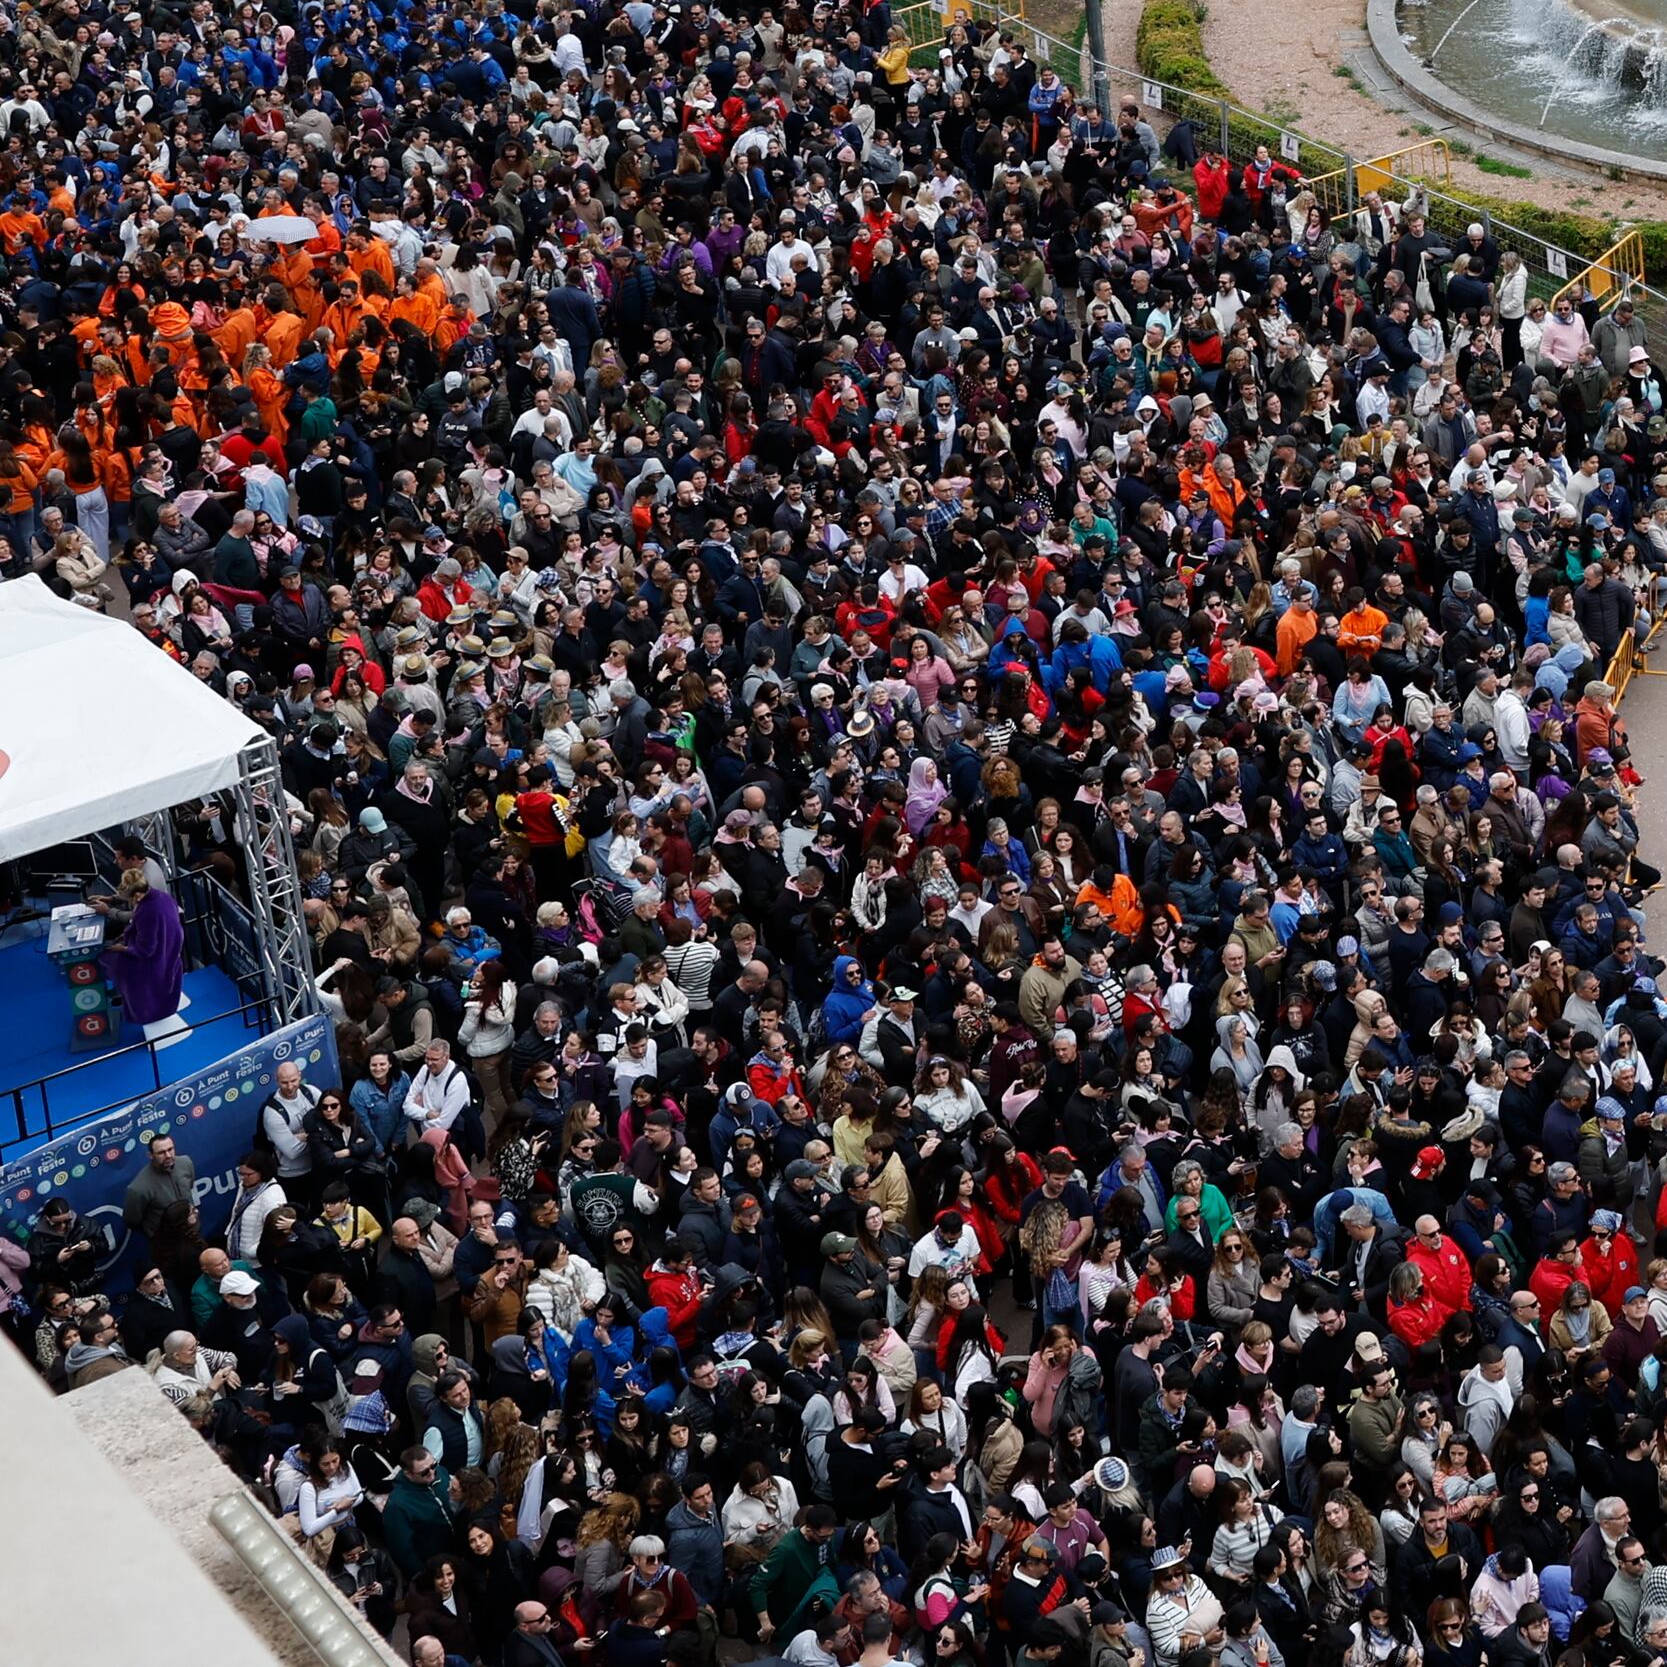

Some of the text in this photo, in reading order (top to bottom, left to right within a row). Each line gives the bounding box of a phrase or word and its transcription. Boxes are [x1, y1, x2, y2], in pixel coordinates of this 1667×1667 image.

[206, 1069, 230, 1086] Punt
[137, 1108, 166, 1128] Festa
[38, 1156, 66, 1177] Festa
